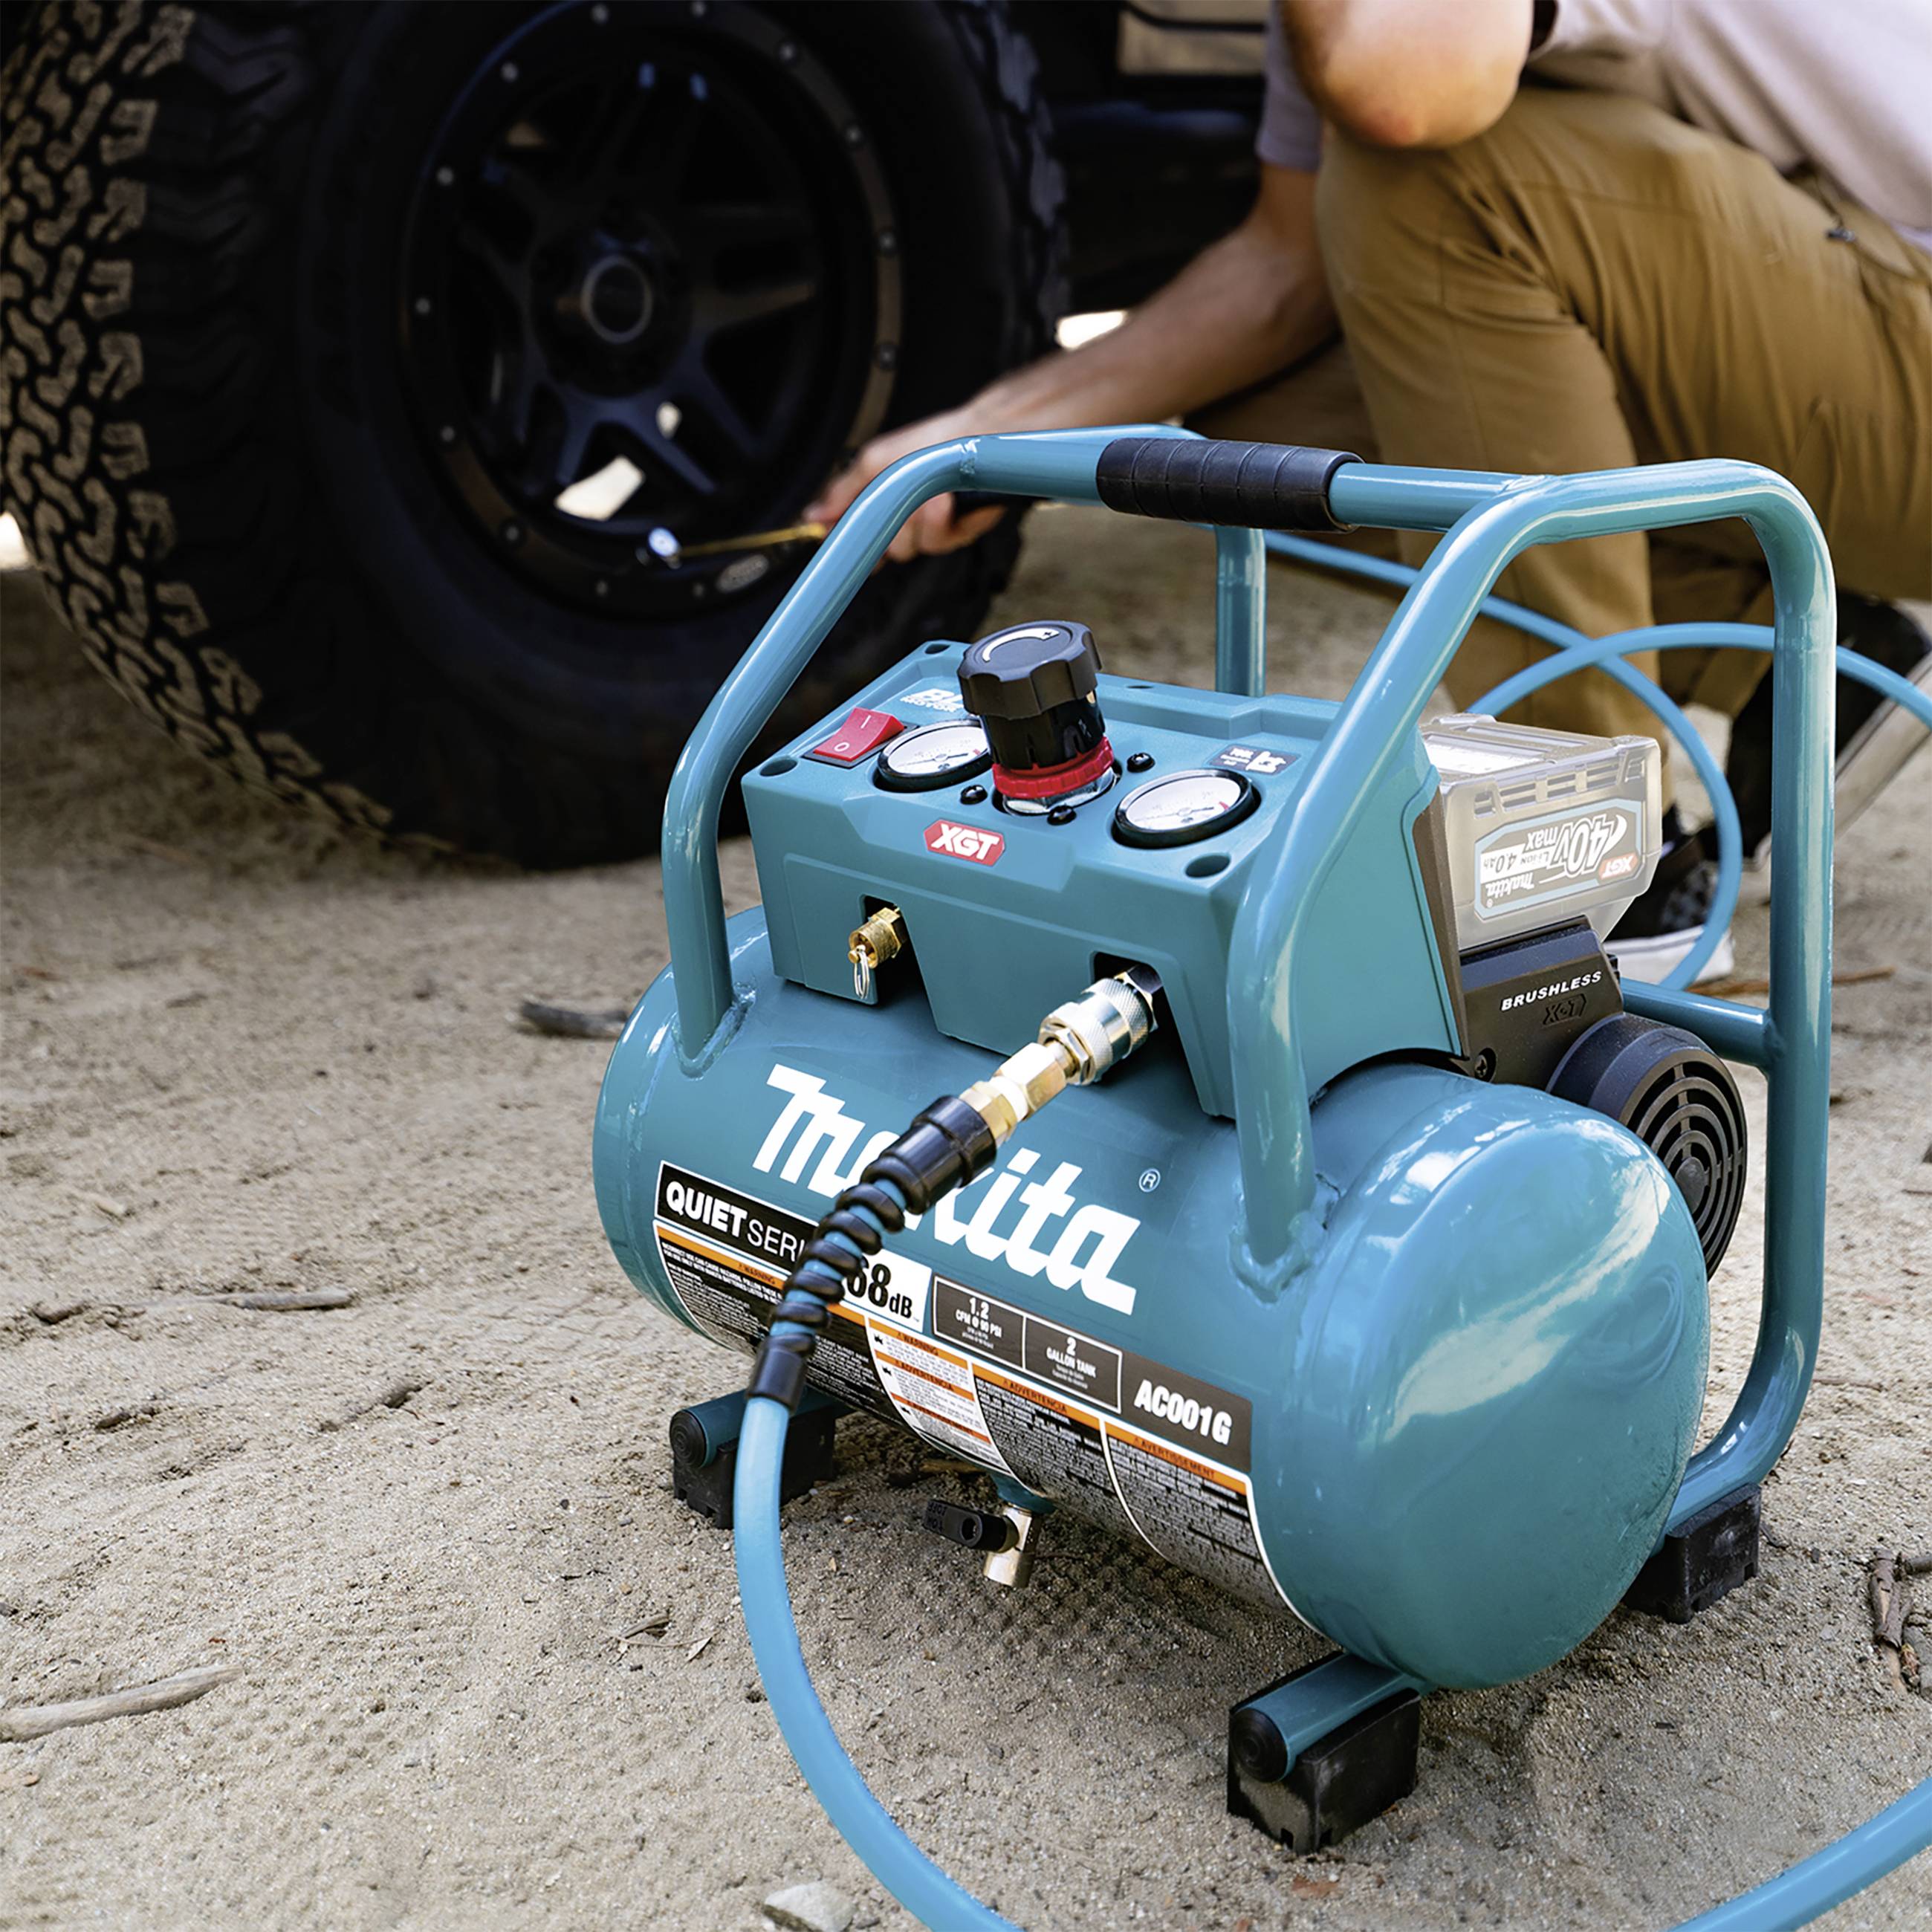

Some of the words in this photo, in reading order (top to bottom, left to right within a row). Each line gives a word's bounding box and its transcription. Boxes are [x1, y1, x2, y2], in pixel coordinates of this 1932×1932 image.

[931, 823, 1000, 860] XGT
[1601, 855, 1633, 879] XGT
[1485, 871, 1534, 899] makita
[1500, 970, 1602, 1011] BRUSHLESS
[666, 1181, 748, 1239] QUIET
[747, 1219, 805, 1262] SERI
[956, 1309, 971, 1326] CFM
[990, 1323, 1002, 1338] PSI
[969, 1297, 989, 1320] 1.2
[1046, 1346, 1076, 1369] GALLON
[1077, 1358, 1097, 1379] TANK
[1066, 1337, 1077, 1357] 2
[1134, 1379, 1233, 1445] AC001G
